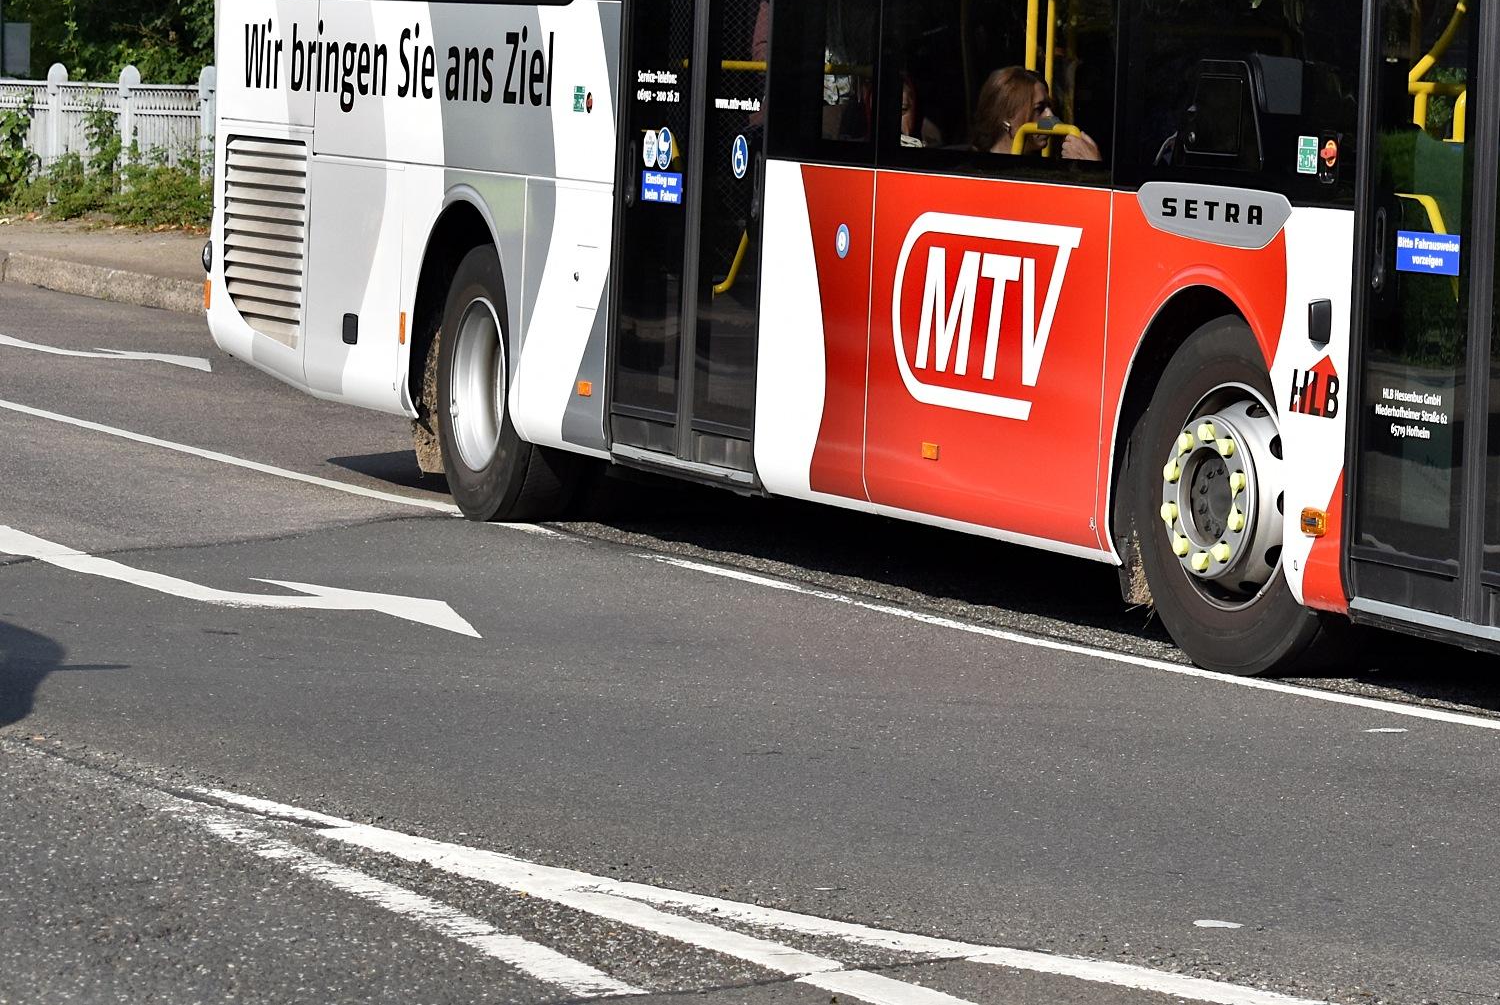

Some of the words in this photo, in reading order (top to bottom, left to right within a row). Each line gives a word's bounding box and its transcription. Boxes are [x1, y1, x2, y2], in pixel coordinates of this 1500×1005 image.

[244, 18, 283, 91] Wir
[289, 19, 388, 113] bringen
[398, 23, 435, 101] Sie
[446, 44, 494, 104] ans
[502, 25, 555, 107] Ziel
[1162, 197, 1263, 225] SETRA
[1397, 236, 1413, 248] Bitte
[1414, 237, 1460, 253] Fahrausweise
[1411, 254, 1443, 268] vorzeigen
[912, 228, 1083, 388] MTV
[1289, 367, 1340, 419] HLB
[1394, 389, 1423, 403] Hessenbus
[1423, 393, 1442, 406] GmbH
[1421, 410, 1440, 424] Straße
[1406, 424, 1431, 439] Hofheim
